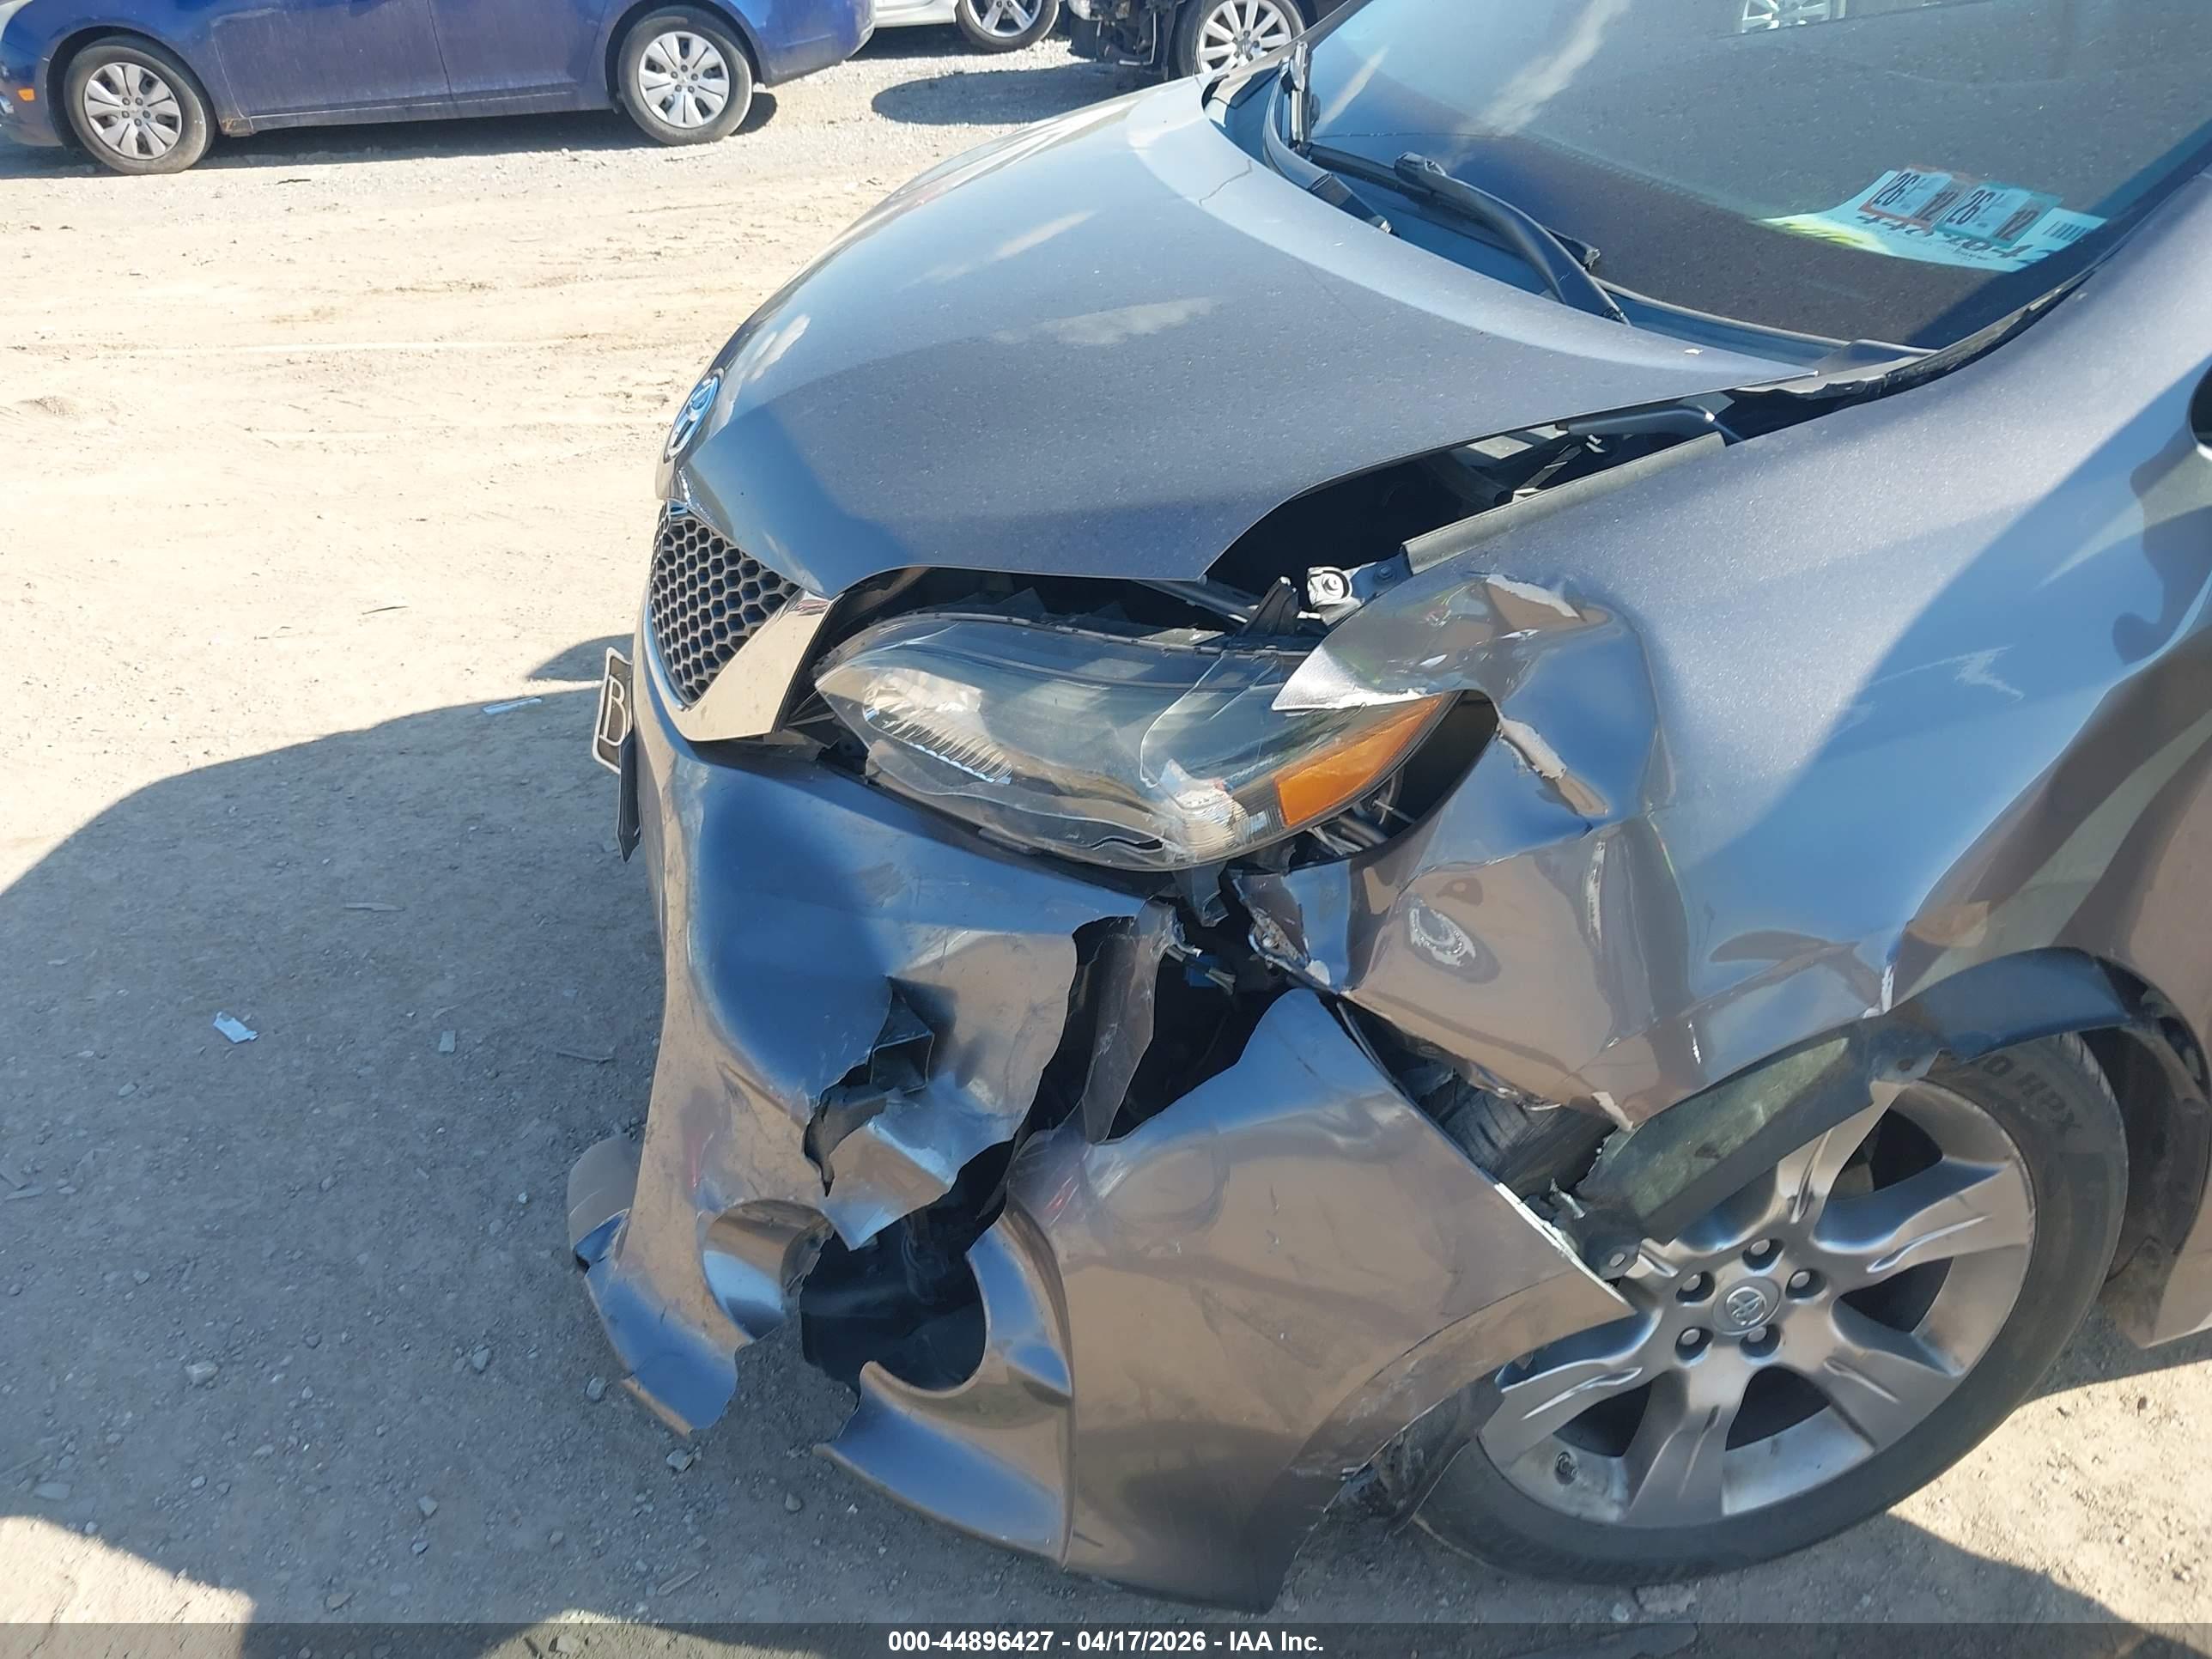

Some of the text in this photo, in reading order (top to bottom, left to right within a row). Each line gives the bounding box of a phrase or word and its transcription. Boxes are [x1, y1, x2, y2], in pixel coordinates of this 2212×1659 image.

[1873, 172, 1920, 206] 26
[1946, 190, 1996, 225] 26
[1994, 209, 2040, 240] 12
[599, 674, 631, 746] B
